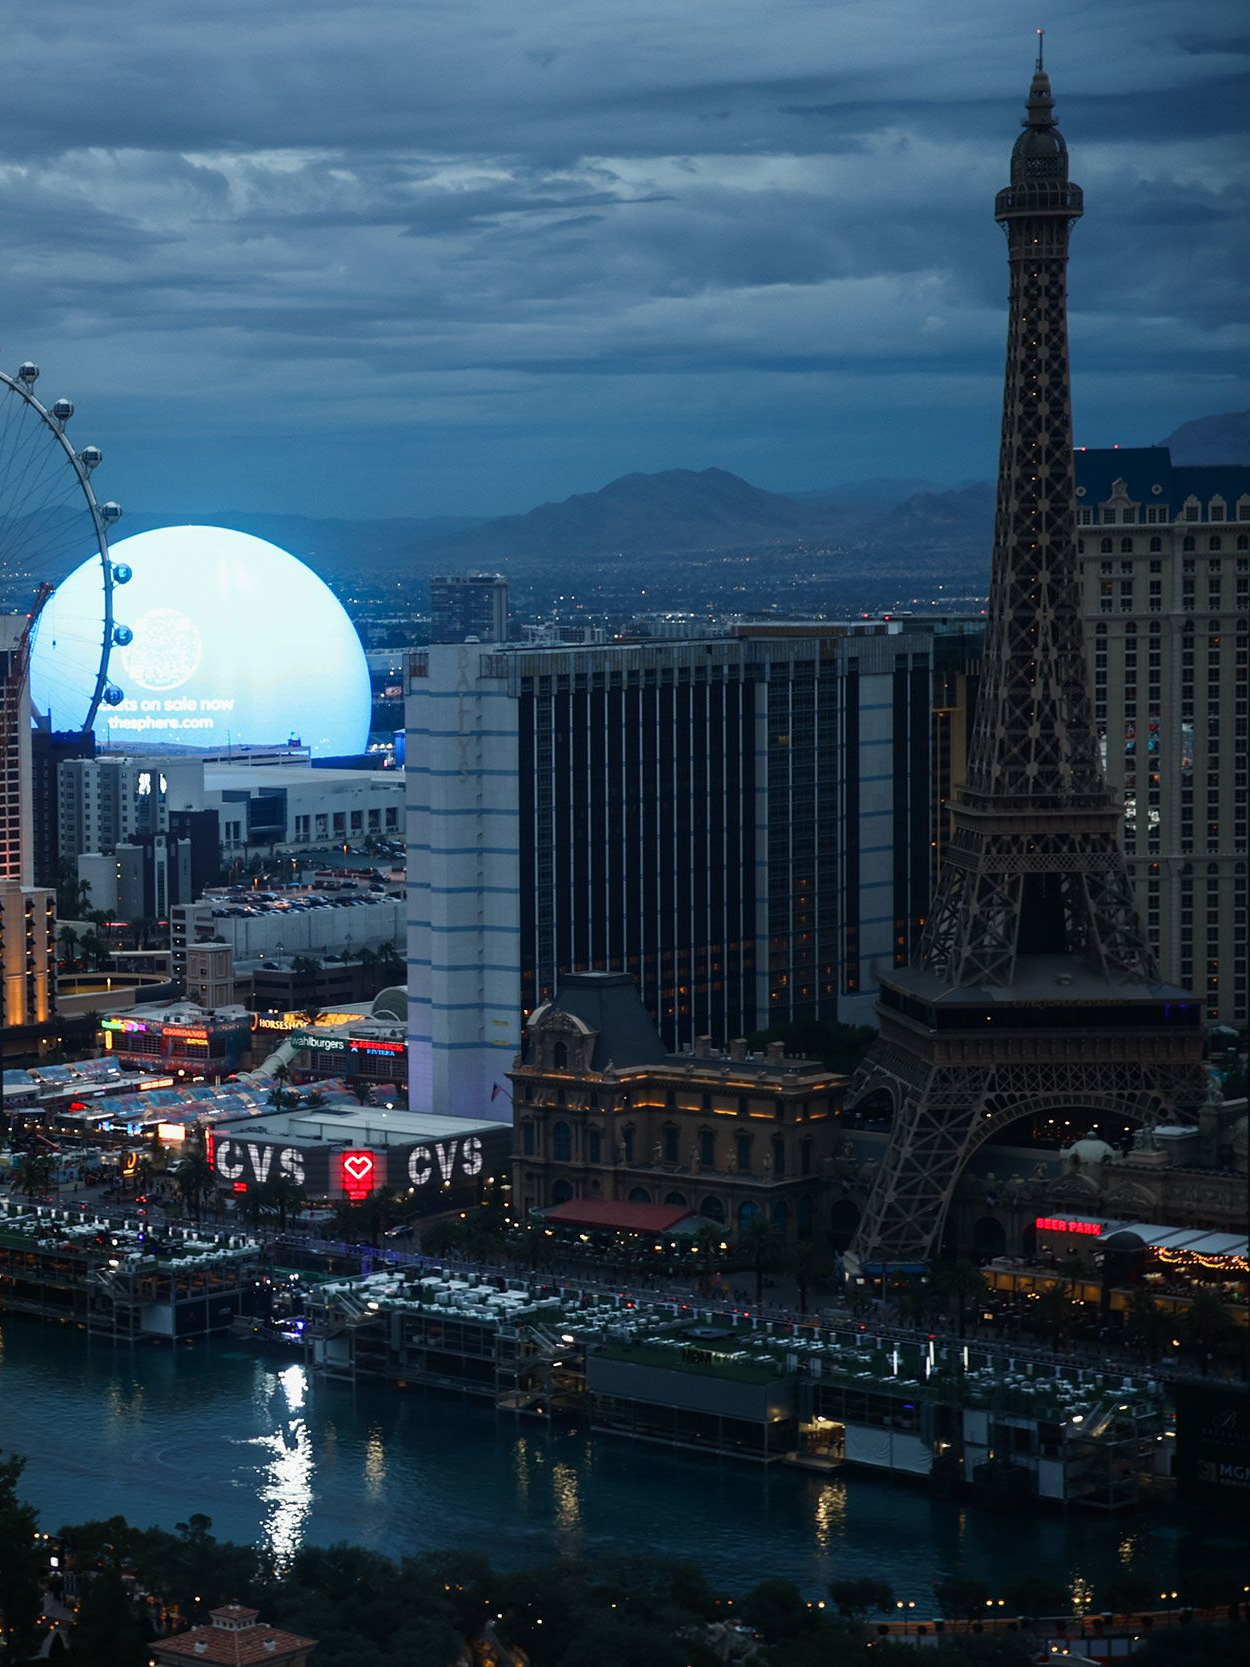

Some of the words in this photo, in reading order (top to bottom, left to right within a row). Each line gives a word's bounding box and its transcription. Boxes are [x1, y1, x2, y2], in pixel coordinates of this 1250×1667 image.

[141, 699, 161, 711] on
[164, 696, 197, 711] sale
[200, 699, 235, 711] now
[108, 715, 214, 732] thesphere.com
[291, 1037, 344, 1050] wahlburgers
[216, 1140, 306, 1186] CVS
[408, 1137, 483, 1185] CVS
[1035, 1217, 1067, 1231] BEER
[1069, 1221, 1102, 1235] PARK
